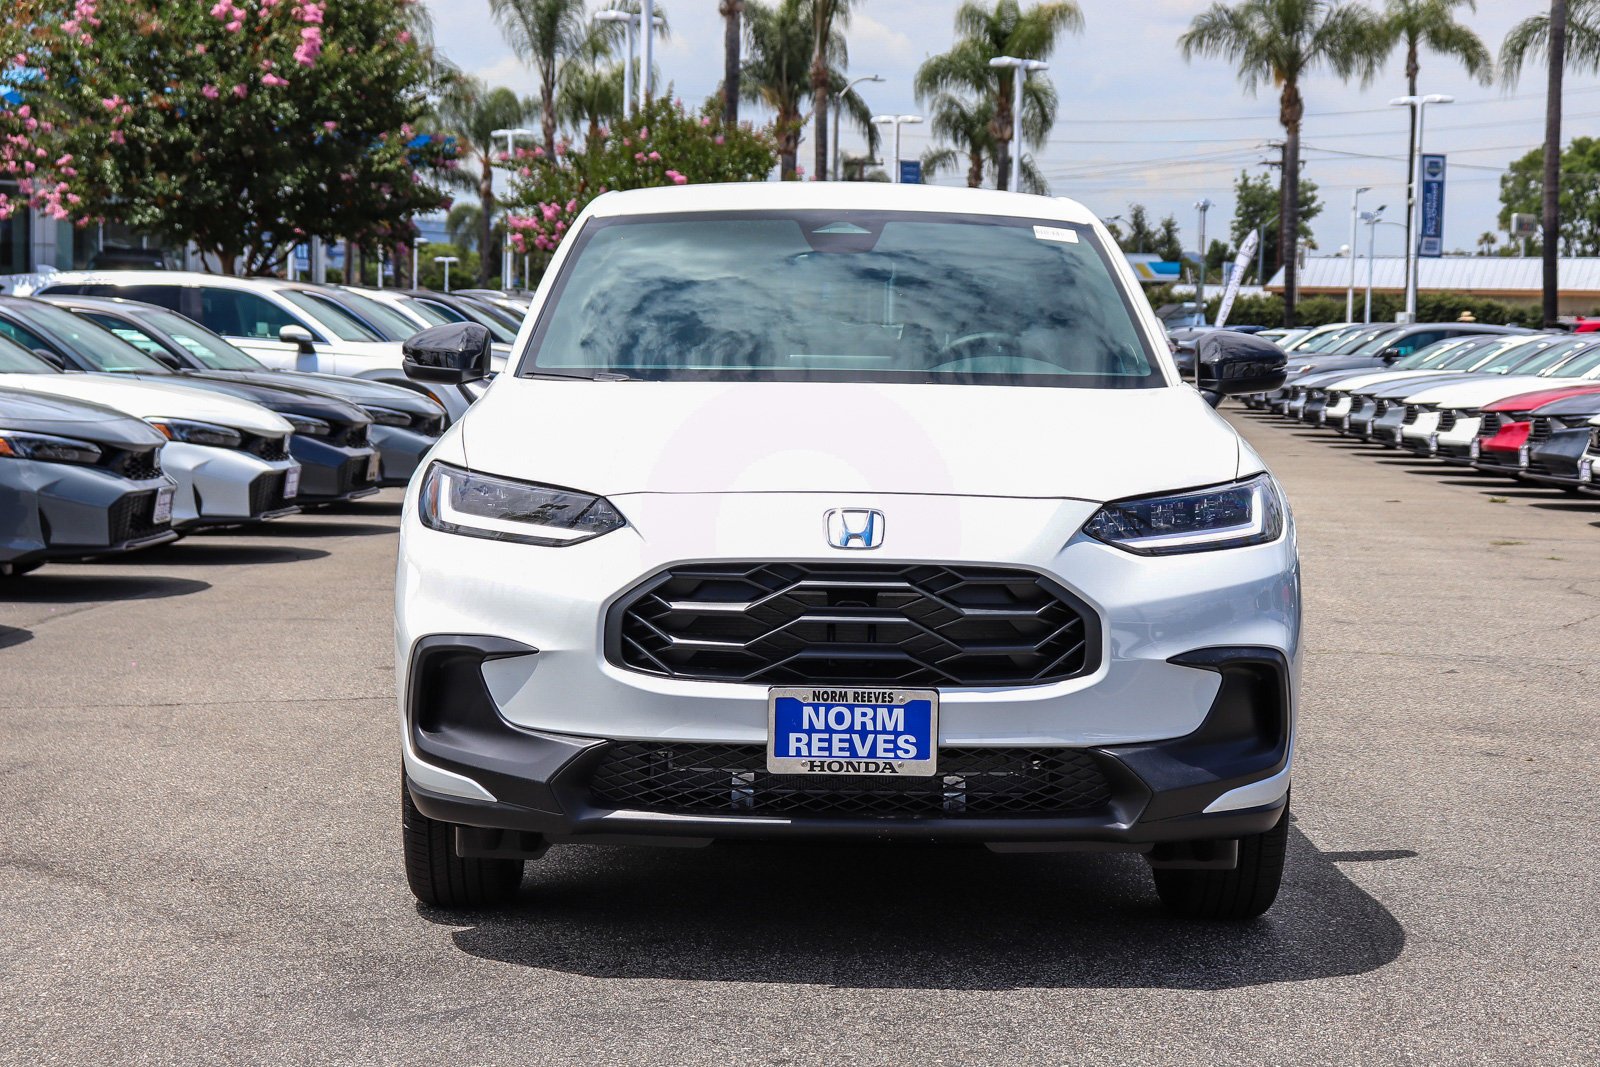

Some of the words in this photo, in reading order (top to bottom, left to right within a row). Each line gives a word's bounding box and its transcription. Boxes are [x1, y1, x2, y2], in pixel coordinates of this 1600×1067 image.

[812, 690, 848, 703] NORM
[852, 691, 894, 704] REEVES
[802, 706, 905, 732] NORM
[788, 732, 918, 759] REEVES
[808, 760, 899, 774] HONDA
